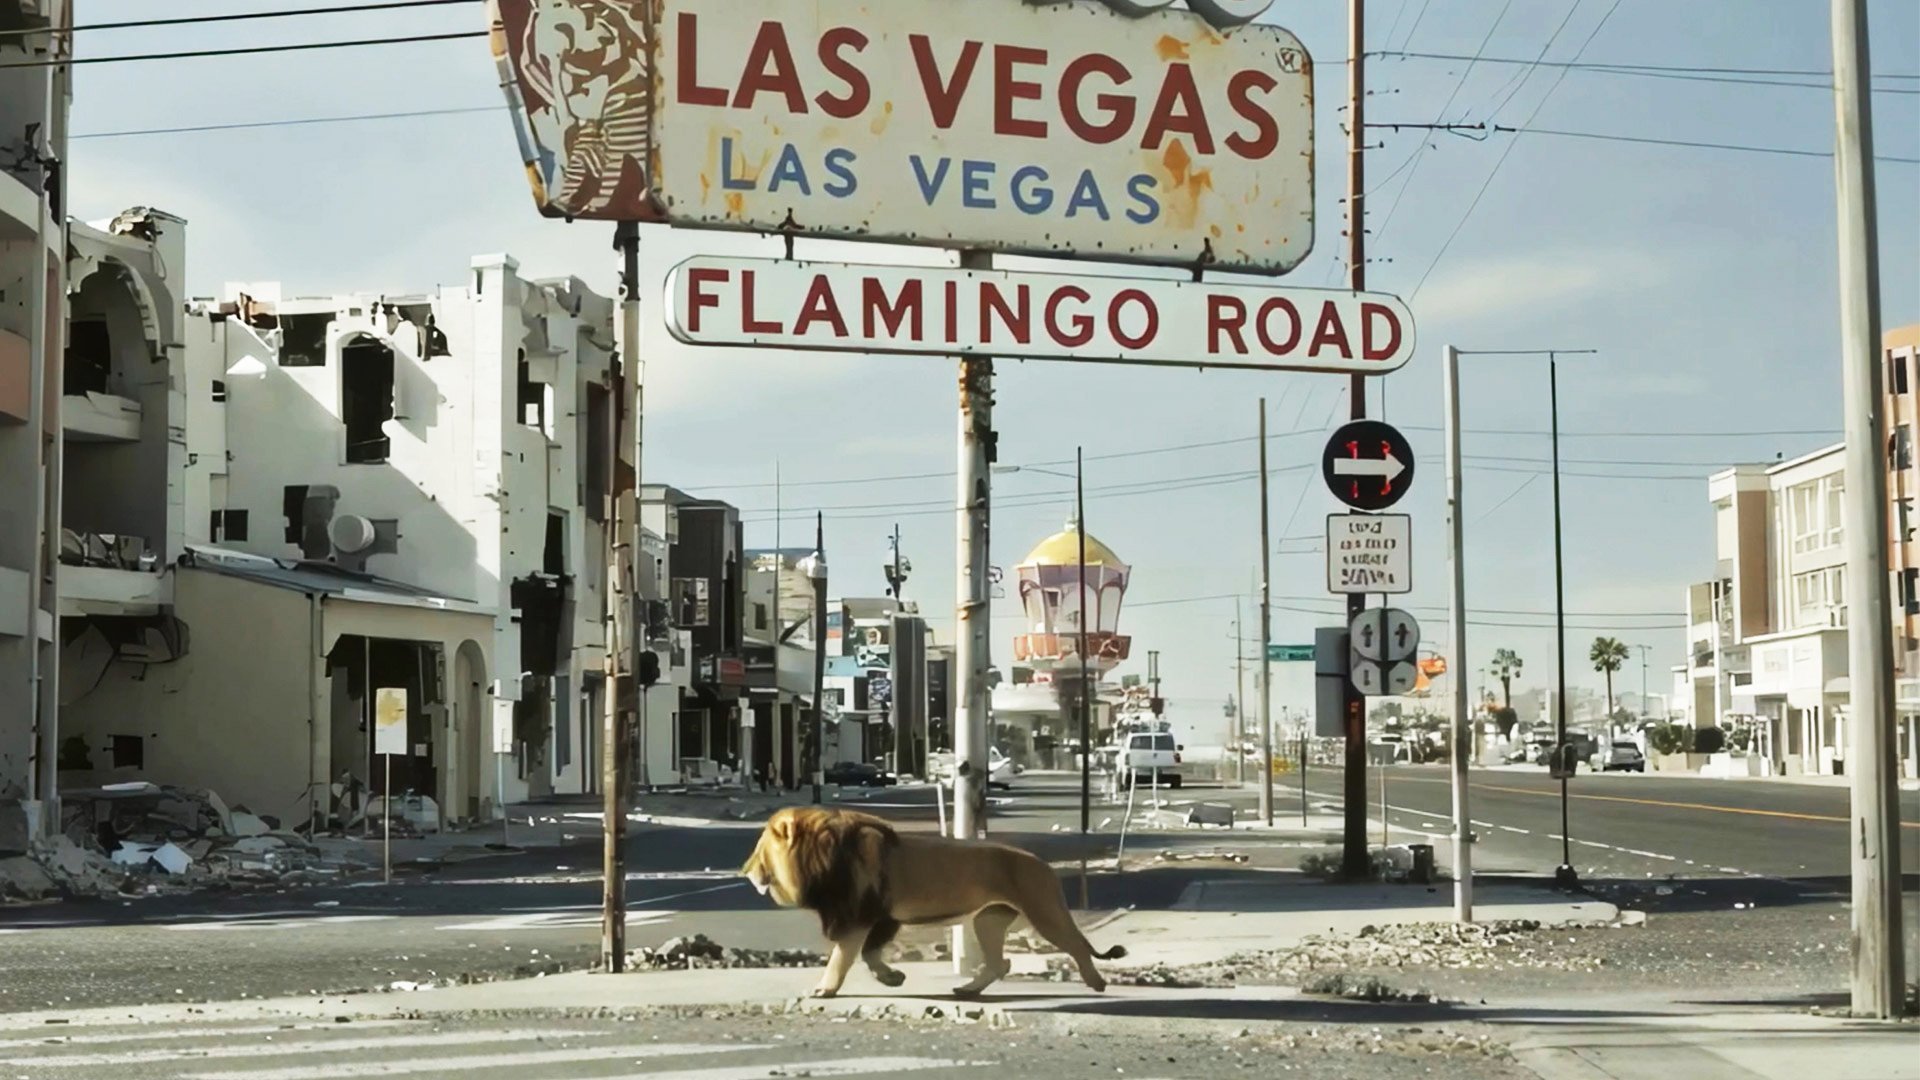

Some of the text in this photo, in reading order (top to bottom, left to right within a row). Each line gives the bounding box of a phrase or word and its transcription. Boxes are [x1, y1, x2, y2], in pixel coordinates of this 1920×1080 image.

[677, 12, 1279, 160] LAS VEGAS
[722, 137, 1161, 225] LAS VEGAS
[688, 268, 1402, 361] FLAMINGO ROAD
